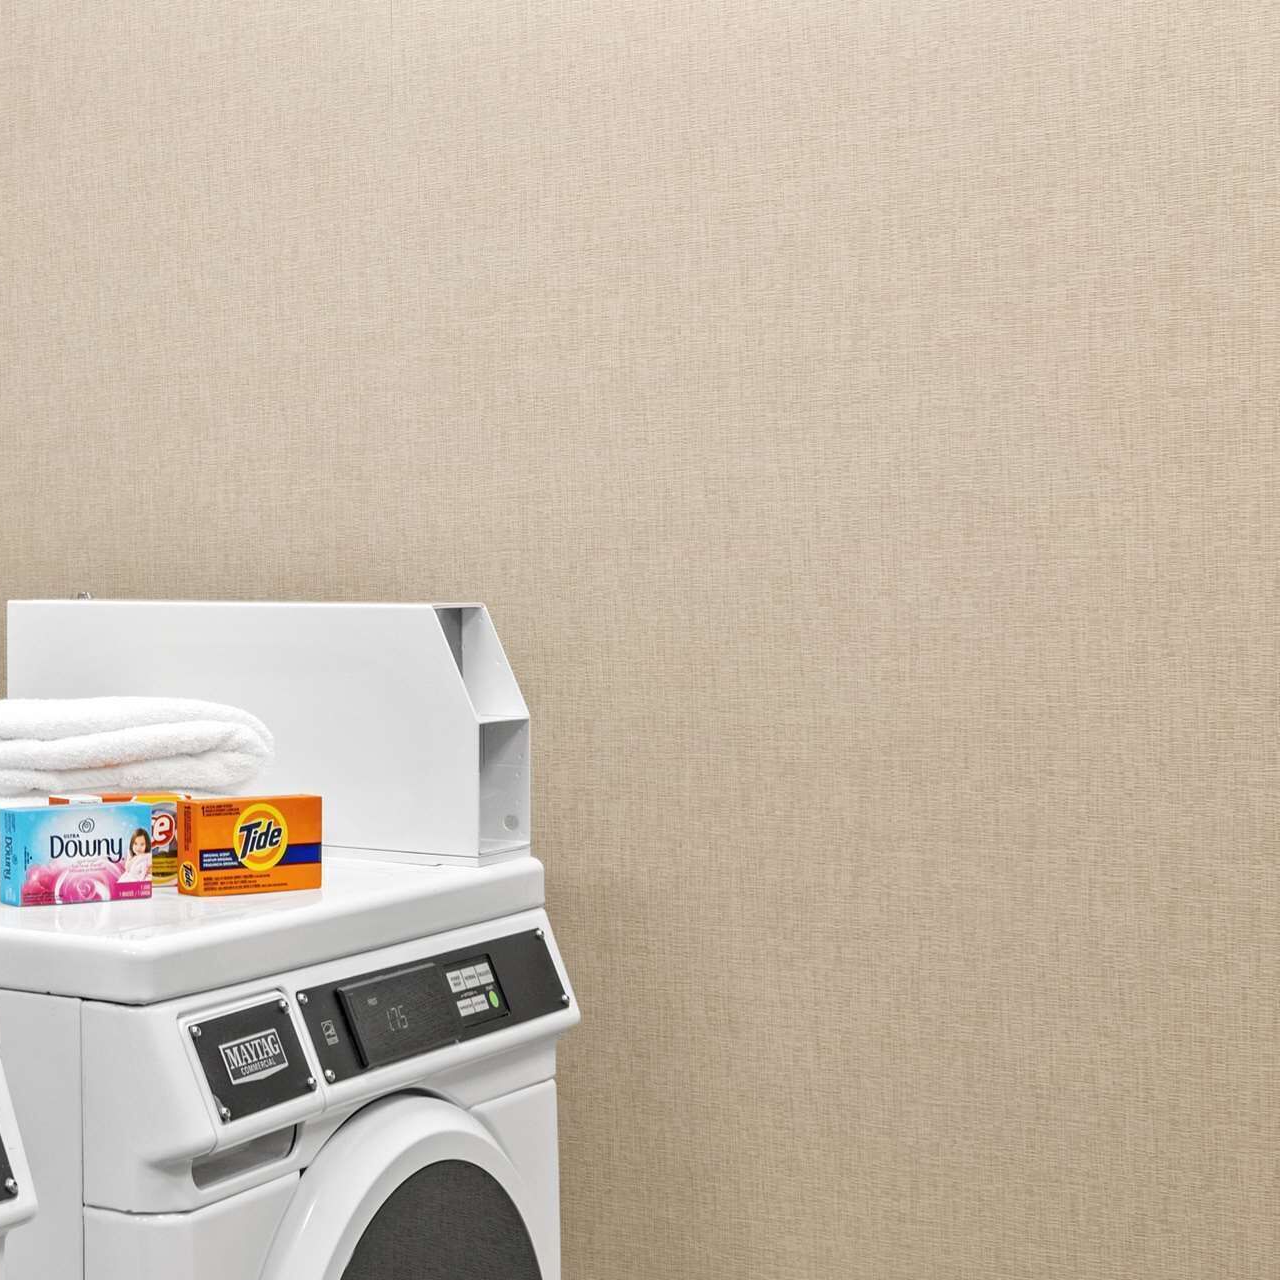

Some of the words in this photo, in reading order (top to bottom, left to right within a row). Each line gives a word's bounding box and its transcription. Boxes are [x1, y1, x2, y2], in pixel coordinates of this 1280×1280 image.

[50, 835, 123, 863] Downy
[239, 820, 283, 860] Tide
[3, 836, 14, 880] Downy
[182, 864, 194, 888] Tide
[224, 1034, 281, 1070] MAYTAG
[240, 1057, 277, 1076] COMMERCIAL
